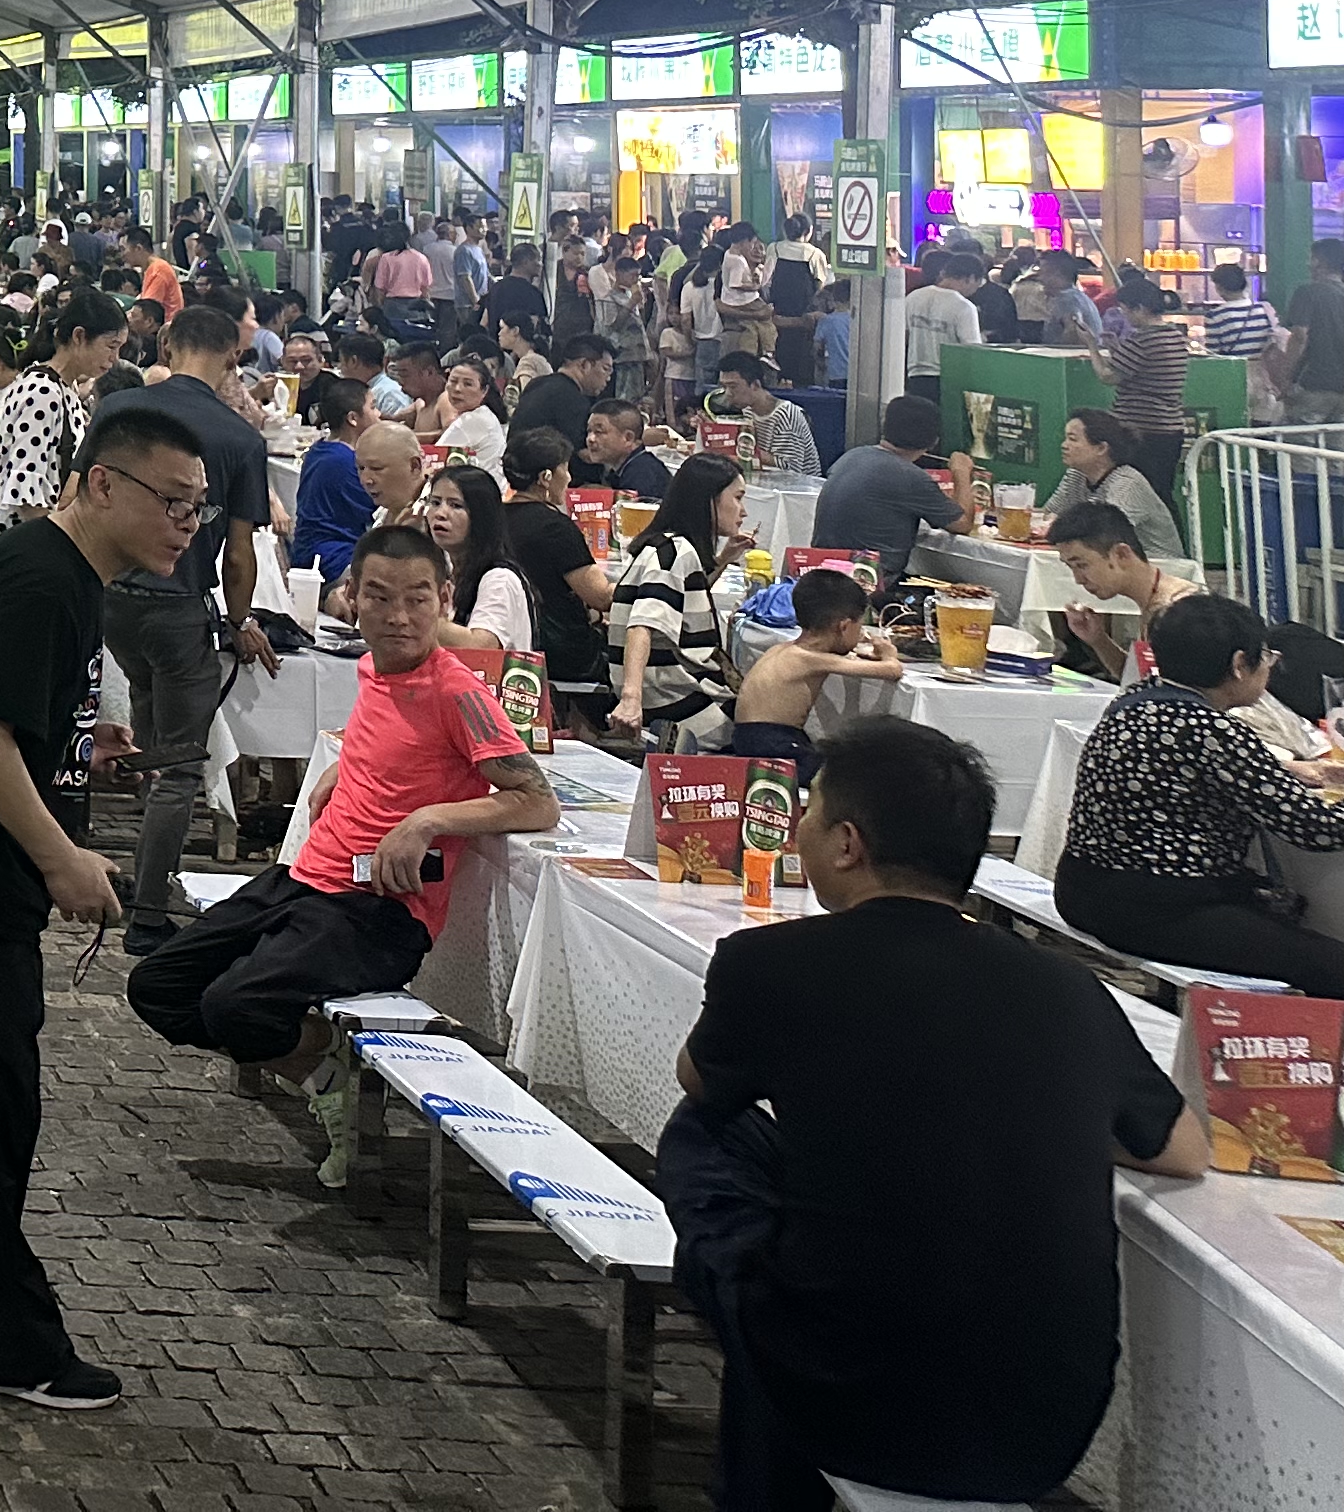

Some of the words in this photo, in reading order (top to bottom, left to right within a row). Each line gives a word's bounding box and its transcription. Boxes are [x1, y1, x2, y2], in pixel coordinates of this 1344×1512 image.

[502, 687, 539, 707] TSINGTAO
[668, 784, 726, 803] 拉环有奖
[745, 805, 790, 829] TSINGTAO
[1220, 1037, 1311, 1059] 拉环有奖
[388, 1052, 464, 1064] JIAODAI
[470, 1125, 552, 1137] JIAODAI
[566, 1211, 655, 1222] JIAODAI
